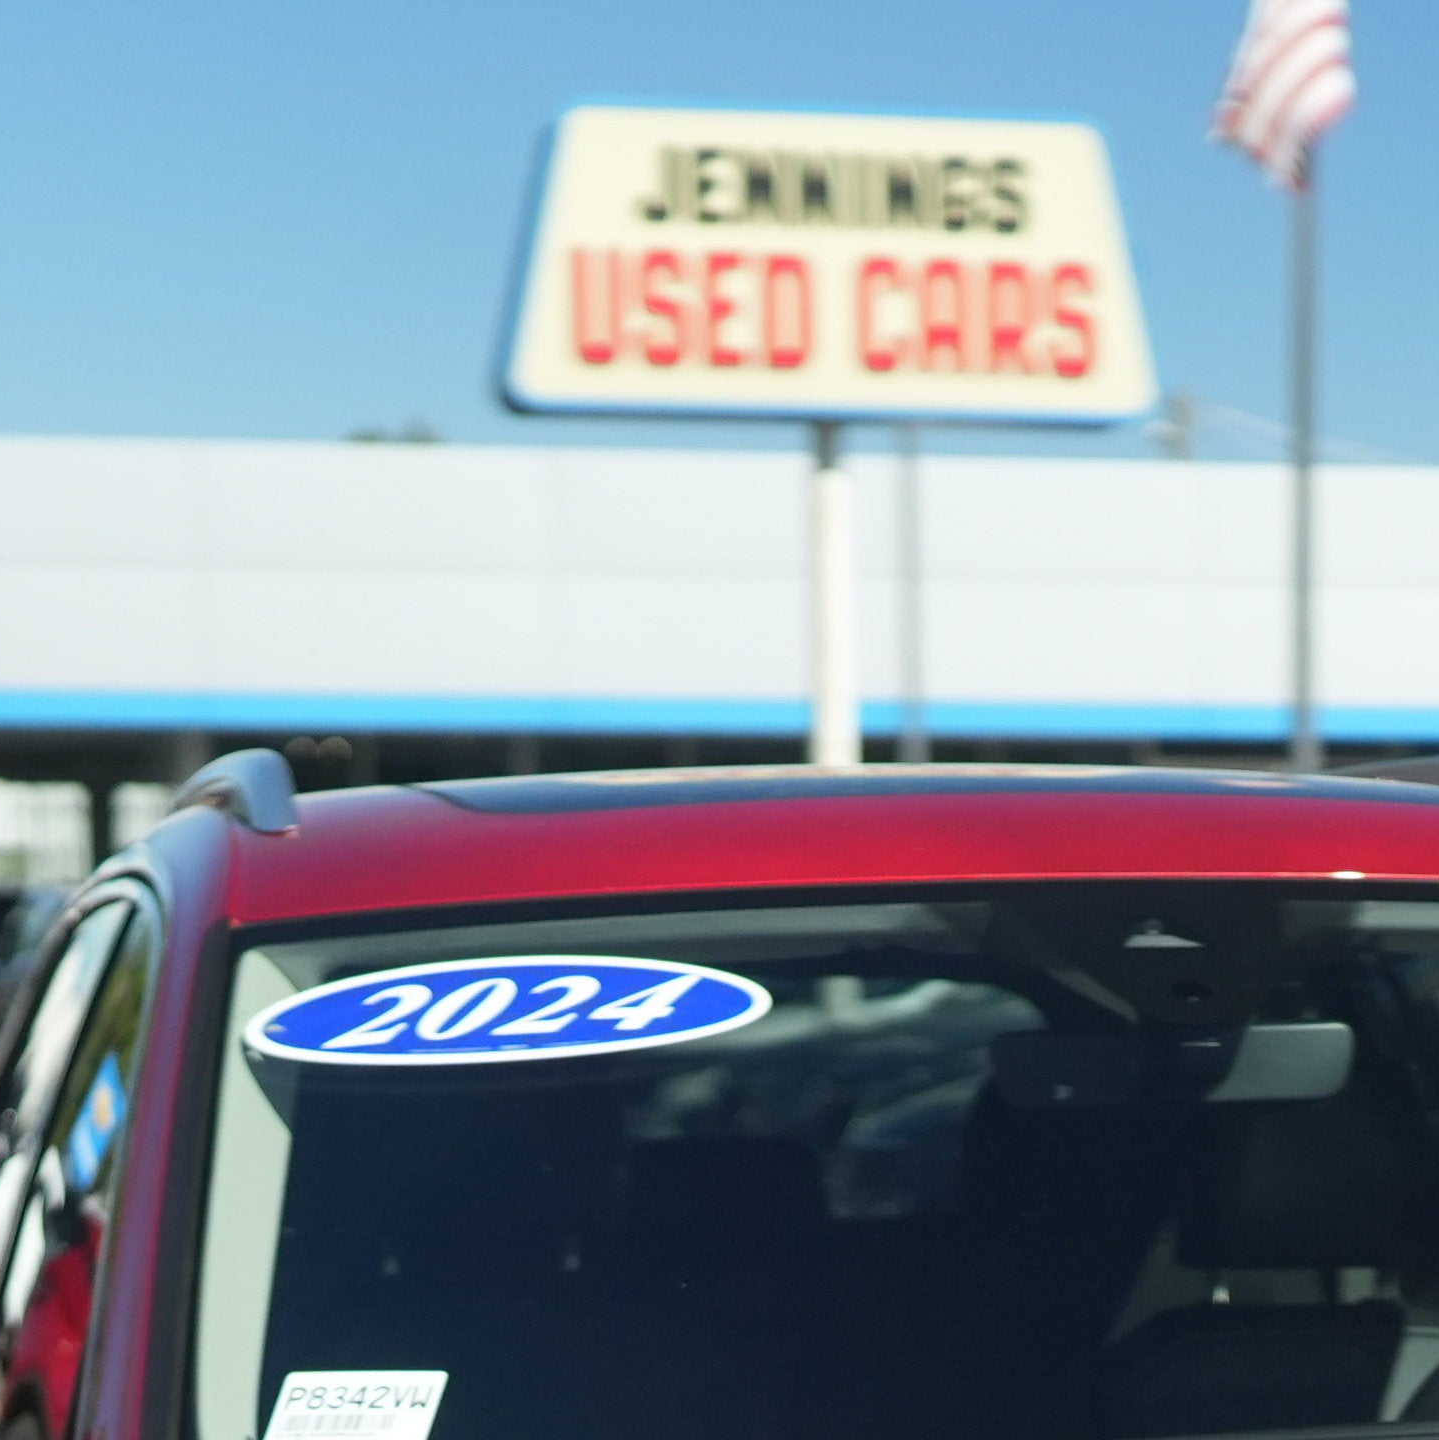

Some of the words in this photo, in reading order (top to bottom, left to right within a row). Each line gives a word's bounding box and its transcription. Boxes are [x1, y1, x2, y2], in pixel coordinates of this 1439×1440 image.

[640, 147, 1025, 234] JENNINGS
[570, 248, 815, 366] USED
[859, 257, 1097, 377] CARS
[320, 975, 709, 1050] 2024
[285, 1385, 434, 1410] P8342VW
